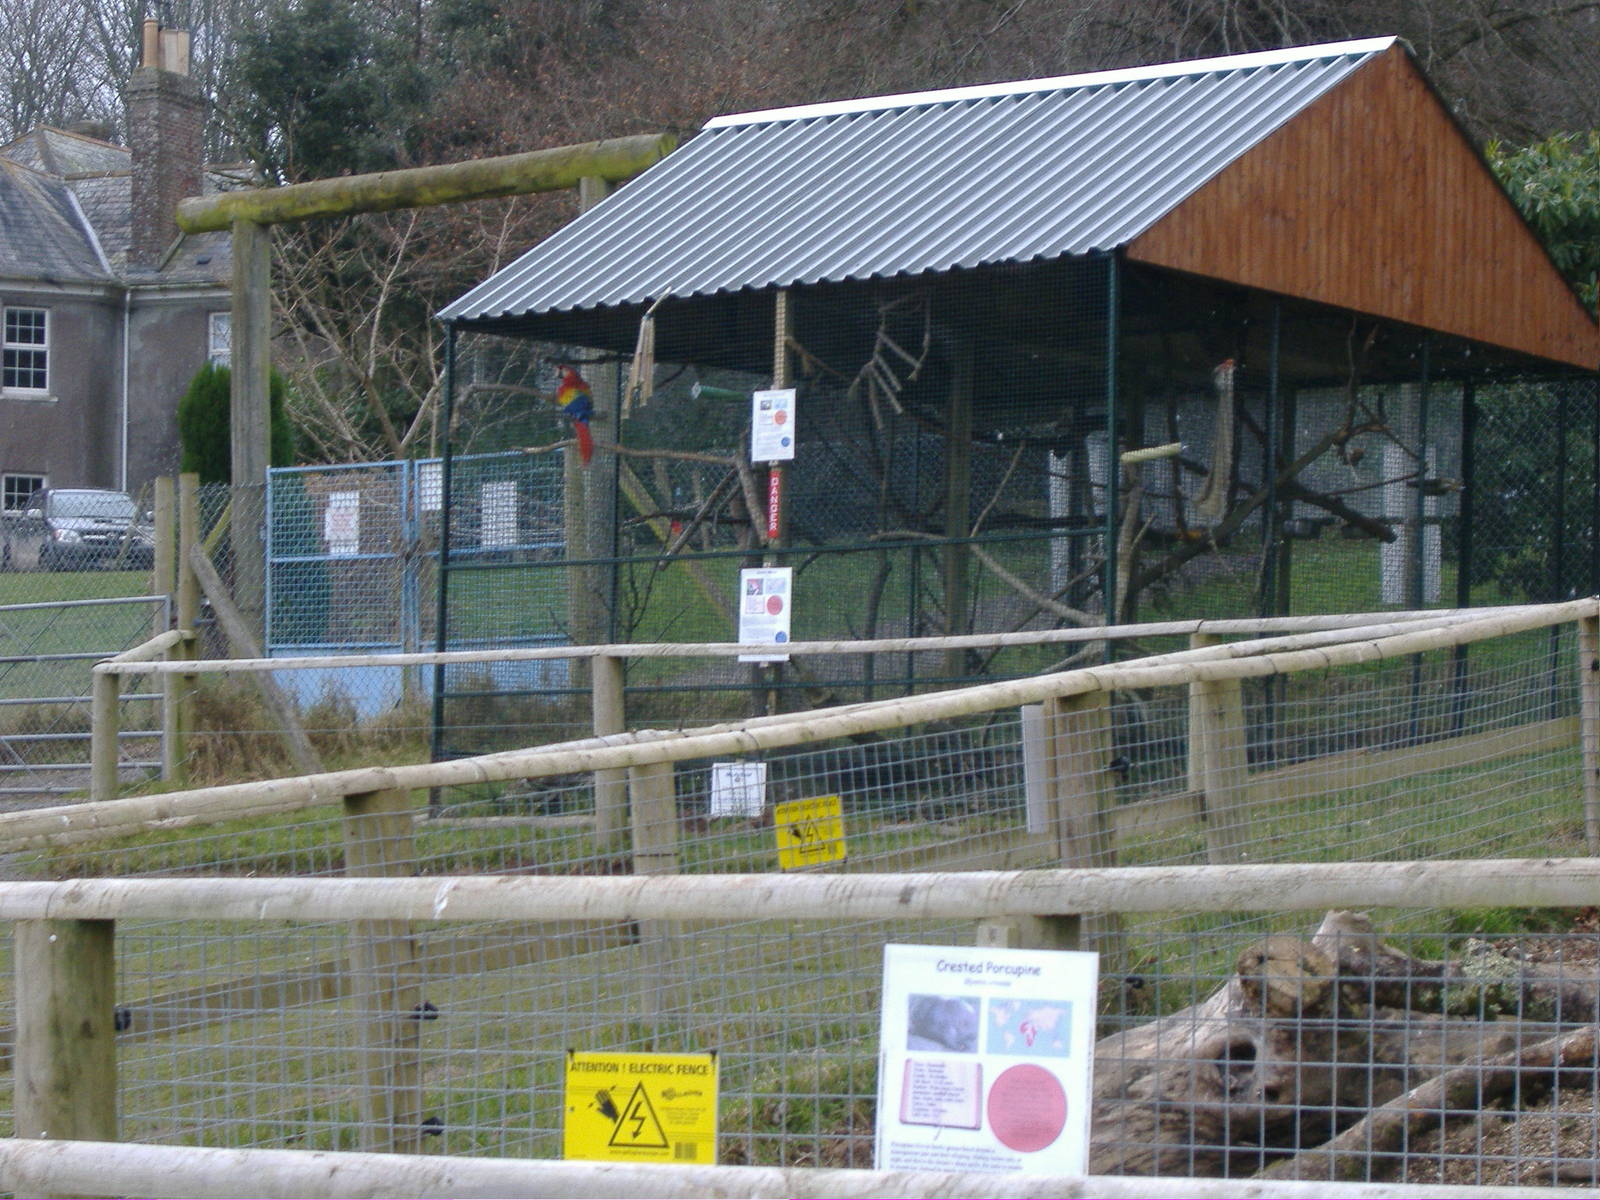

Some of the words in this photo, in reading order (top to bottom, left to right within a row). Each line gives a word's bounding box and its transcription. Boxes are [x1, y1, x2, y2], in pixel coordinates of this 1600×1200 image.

[768, 477, 780, 531] DANGER
[936, 959, 983, 974] Crested
[986, 960, 1041, 977] Porcupine
[570, 1061, 619, 1073] ATTENTION
[629, 1063, 674, 1075] ELECTRIC
[676, 1065, 708, 1075] FENCE
